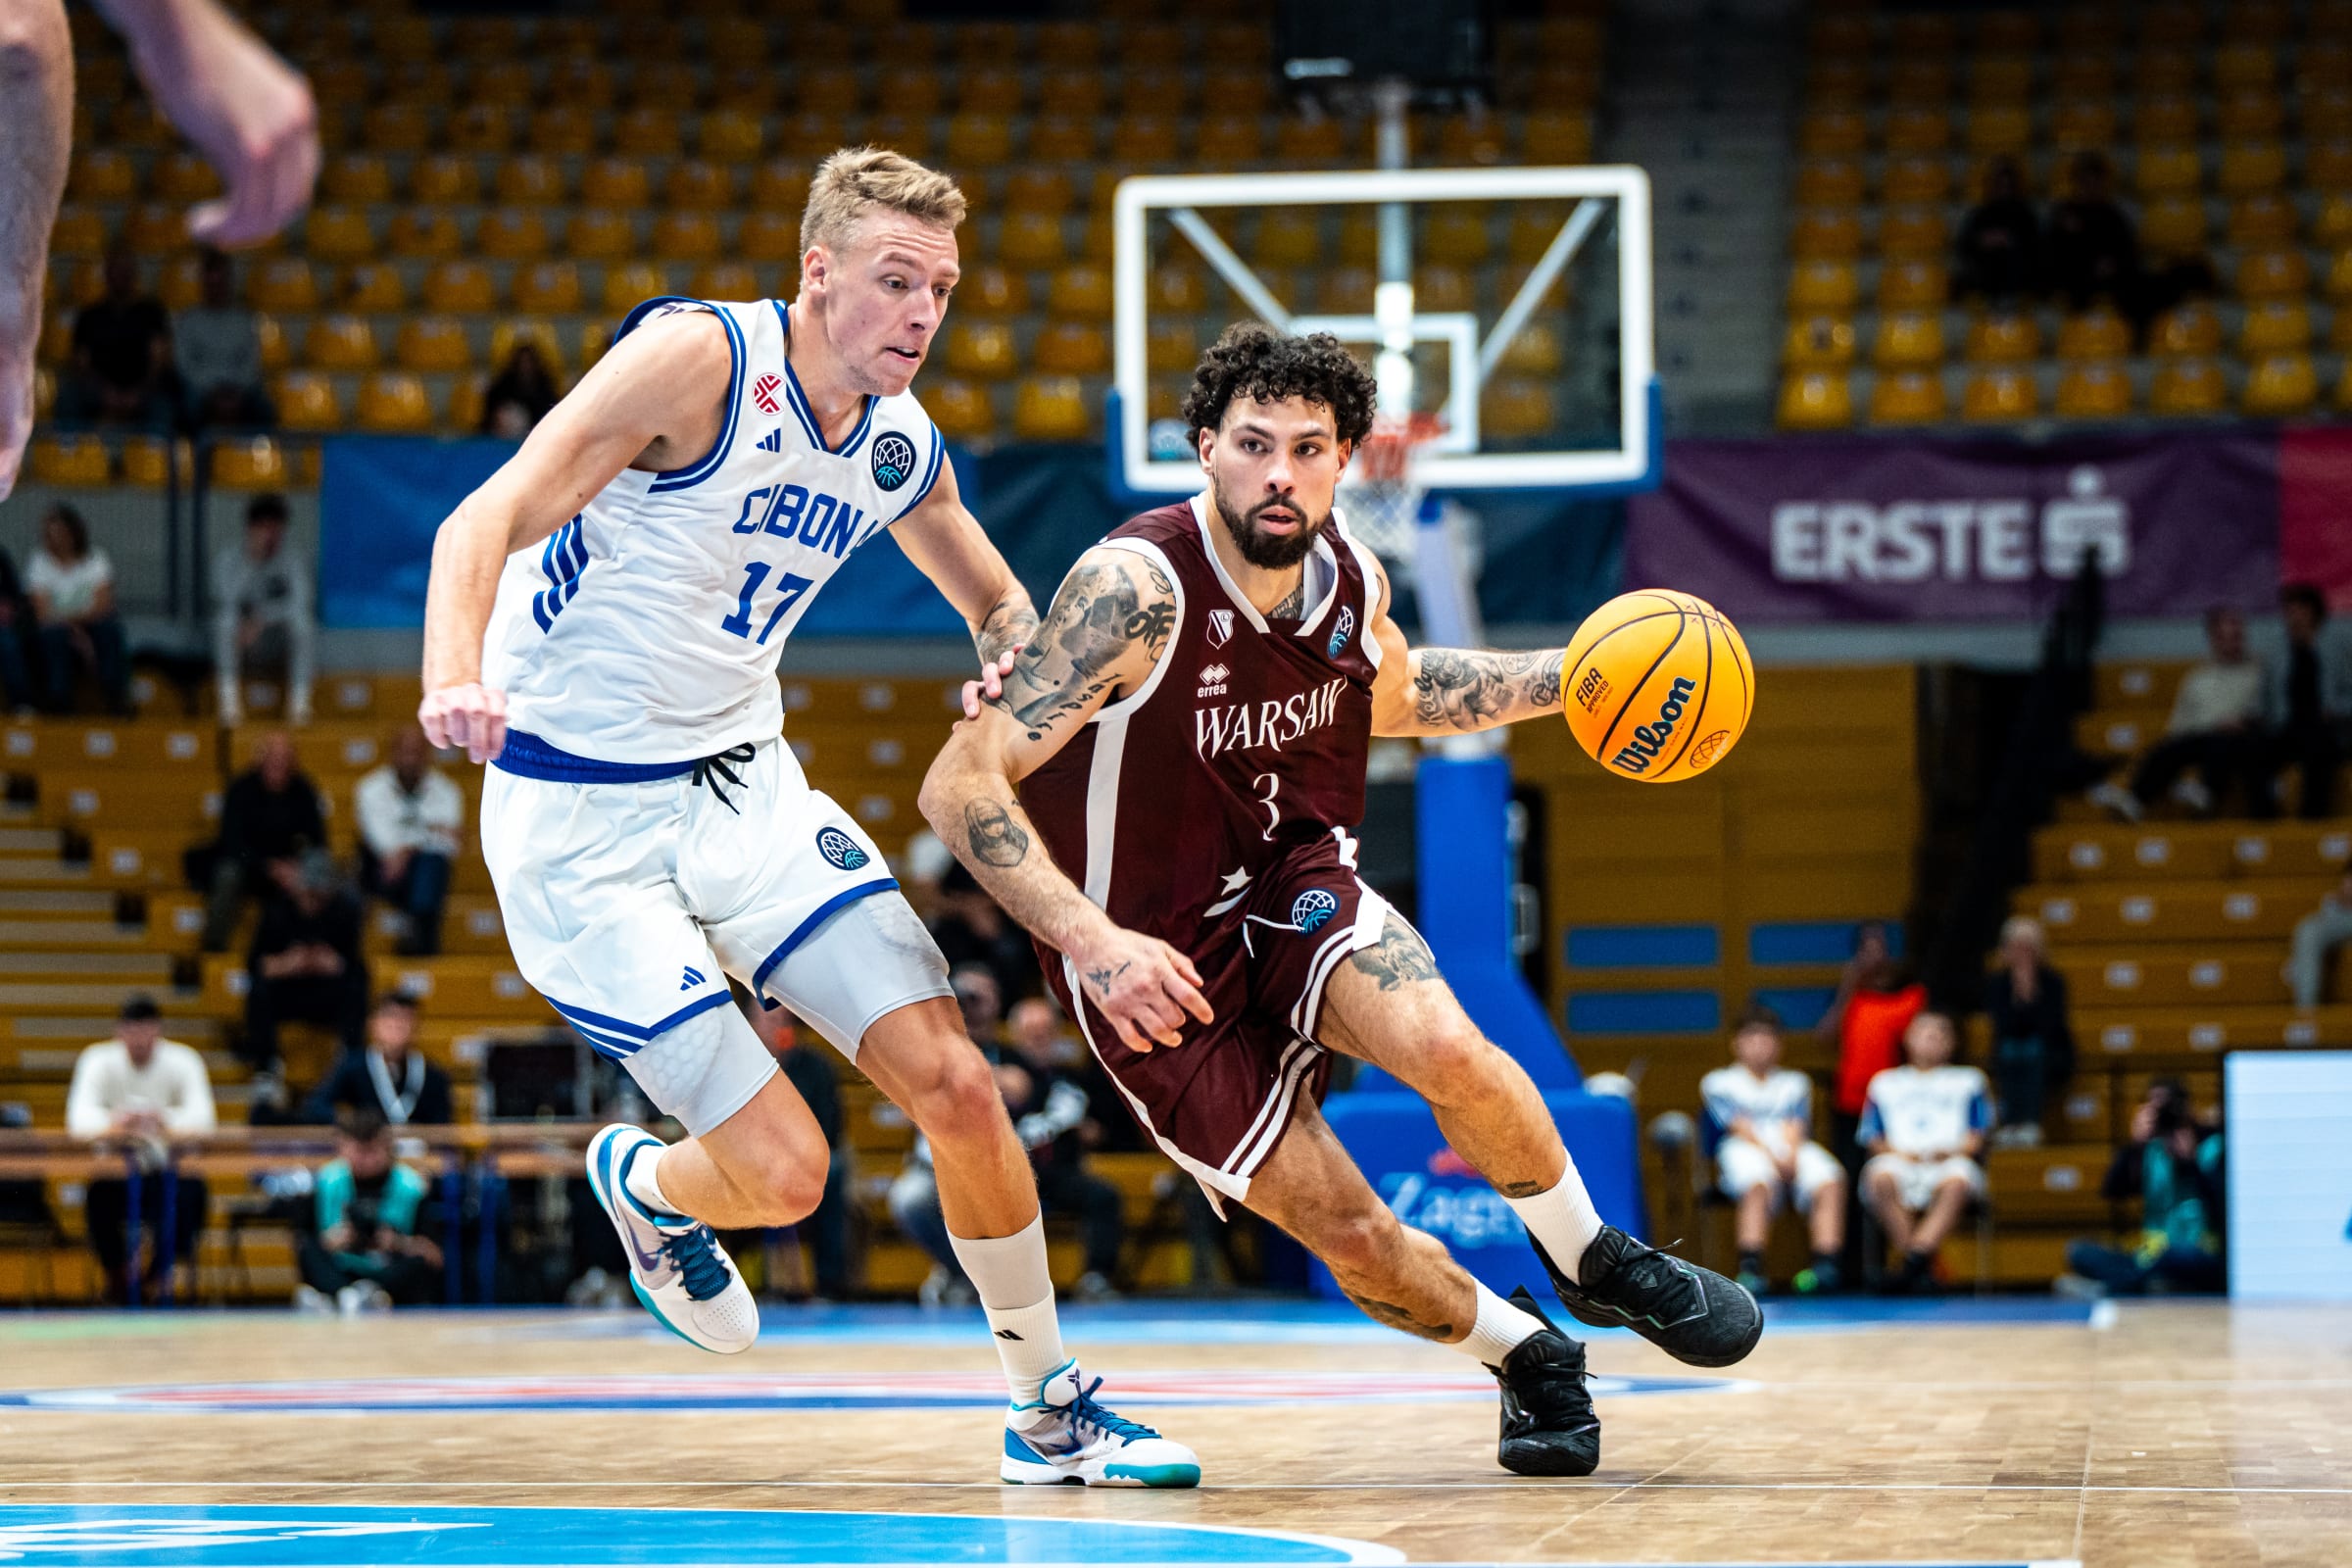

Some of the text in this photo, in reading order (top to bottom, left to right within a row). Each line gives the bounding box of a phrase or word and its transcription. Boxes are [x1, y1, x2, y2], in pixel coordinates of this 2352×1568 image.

[732, 484, 879, 560] CIBON
[1770, 500, 2034, 583] ERSTE
[721, 562, 813, 646] 17
[1195, 674, 1348, 761] WARSAW
[1198, 683, 1227, 698] errea
[1576, 667, 1602, 707] FIBA
[1587, 680, 1609, 713] APPROVED
[1610, 676, 1696, 774] Wilson
[1252, 772, 1280, 842] 3
